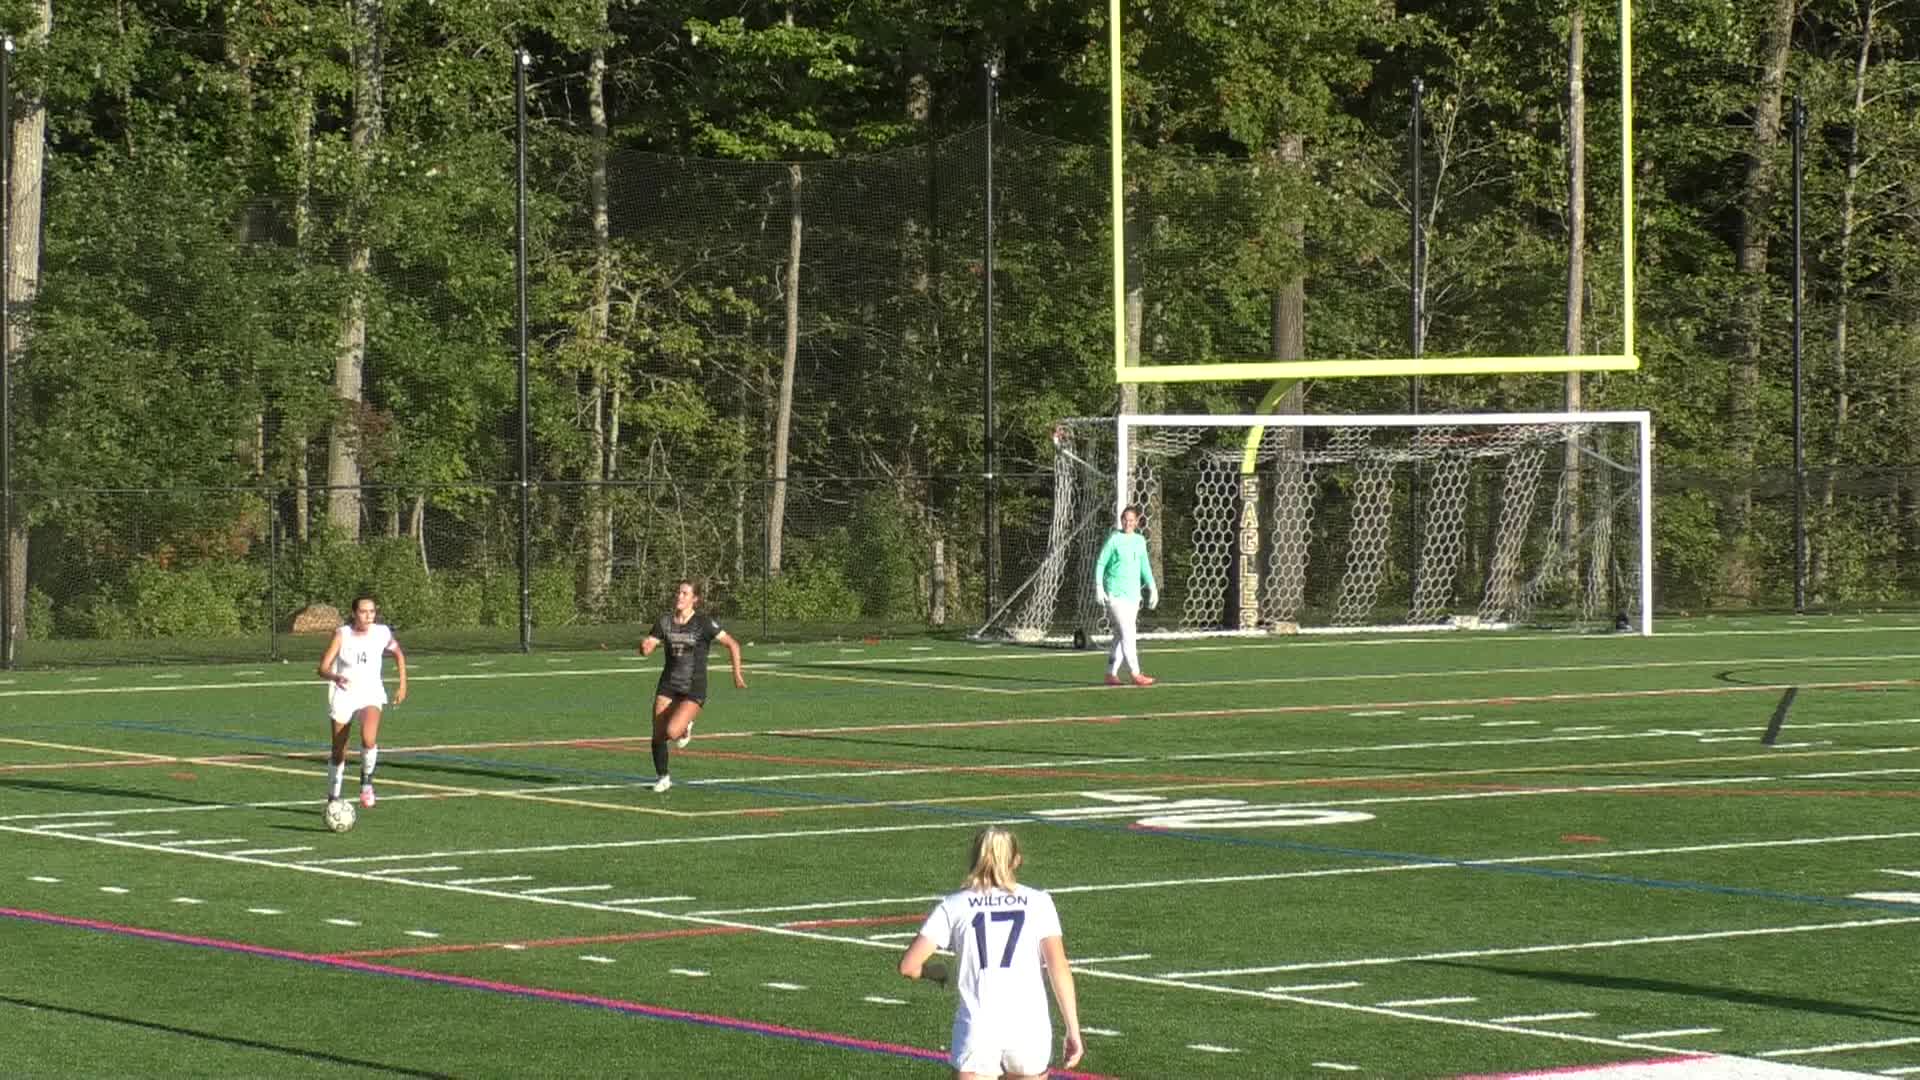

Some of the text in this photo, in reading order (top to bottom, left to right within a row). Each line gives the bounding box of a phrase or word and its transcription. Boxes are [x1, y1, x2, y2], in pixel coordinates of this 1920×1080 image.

[356, 651, 368, 664] 14
[968, 895, 1028, 907] WILTON
[972, 910, 1025, 969] 17
